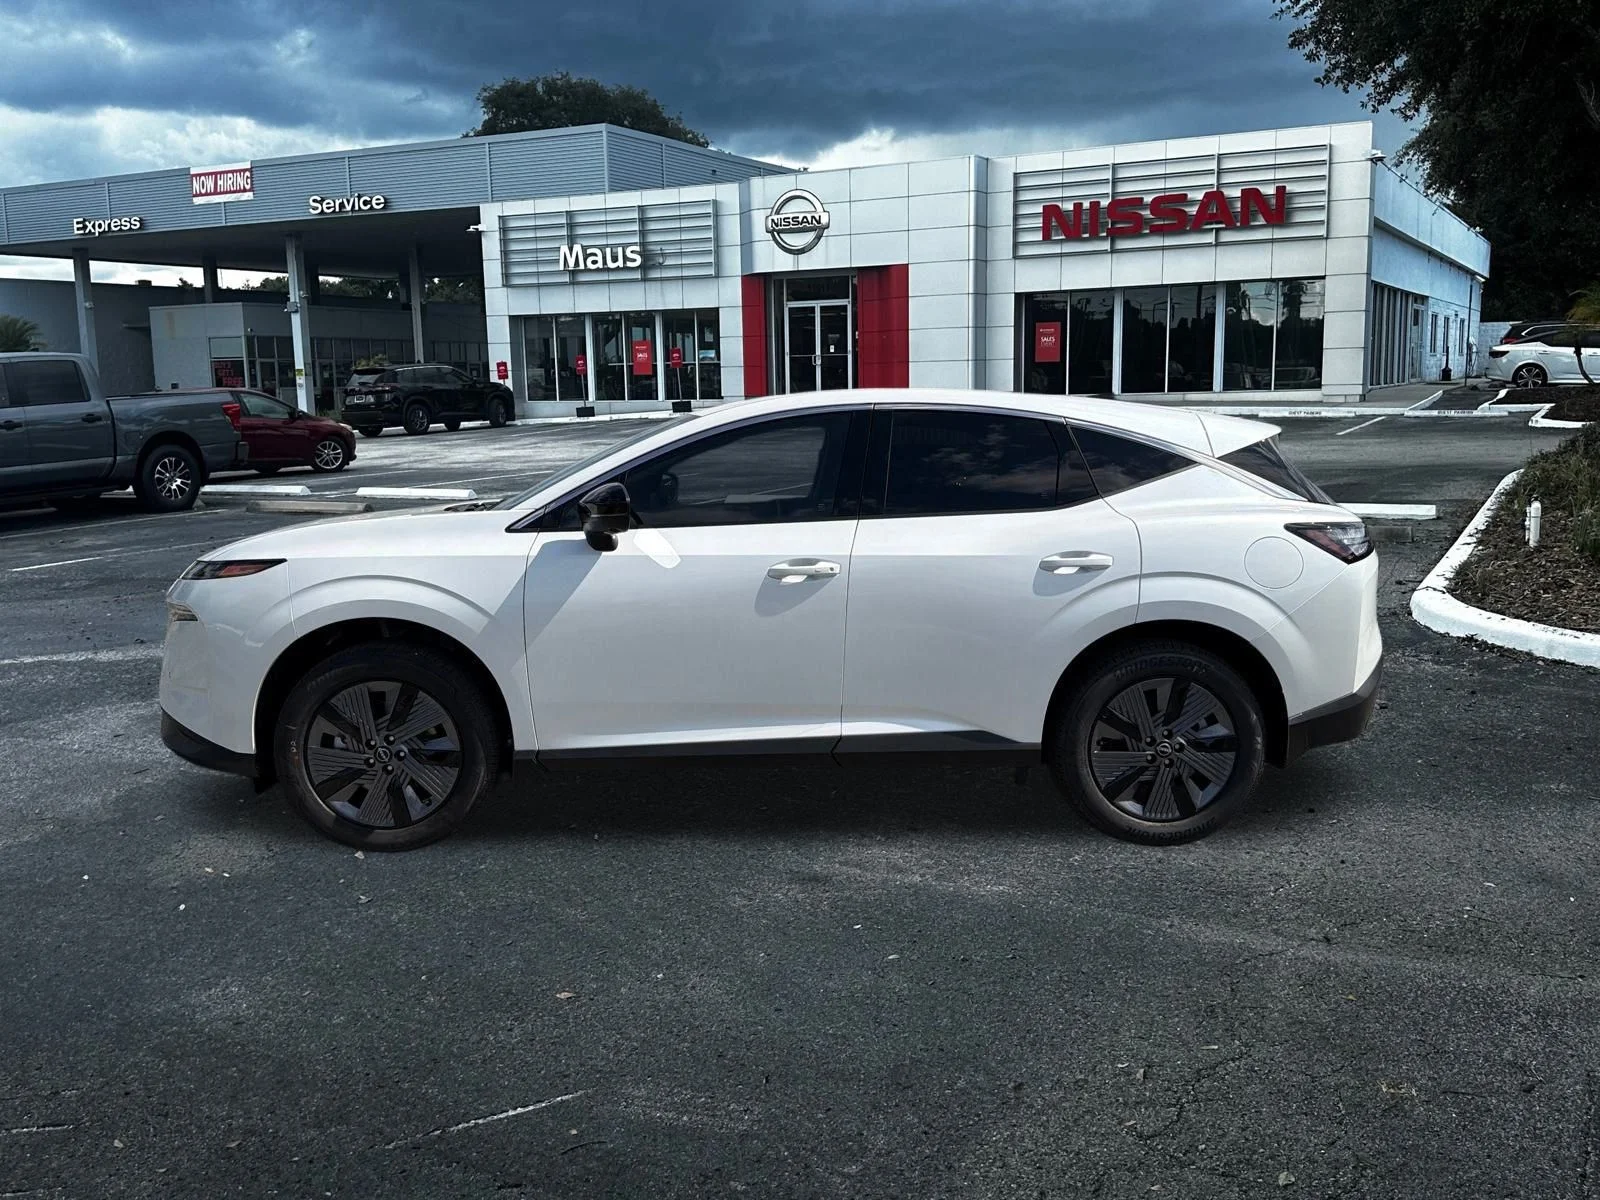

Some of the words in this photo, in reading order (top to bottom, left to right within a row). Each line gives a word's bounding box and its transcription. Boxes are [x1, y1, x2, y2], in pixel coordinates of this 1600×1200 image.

[192, 175, 215, 195] NOW
[217, 171, 251, 192] HIRING
[308, 193, 385, 214] Service
[1042, 185, 1287, 241] NISSAN
[73, 216, 141, 236] Express
[770, 214, 822, 230] NISSAN
[559, 243, 642, 270] Maus
